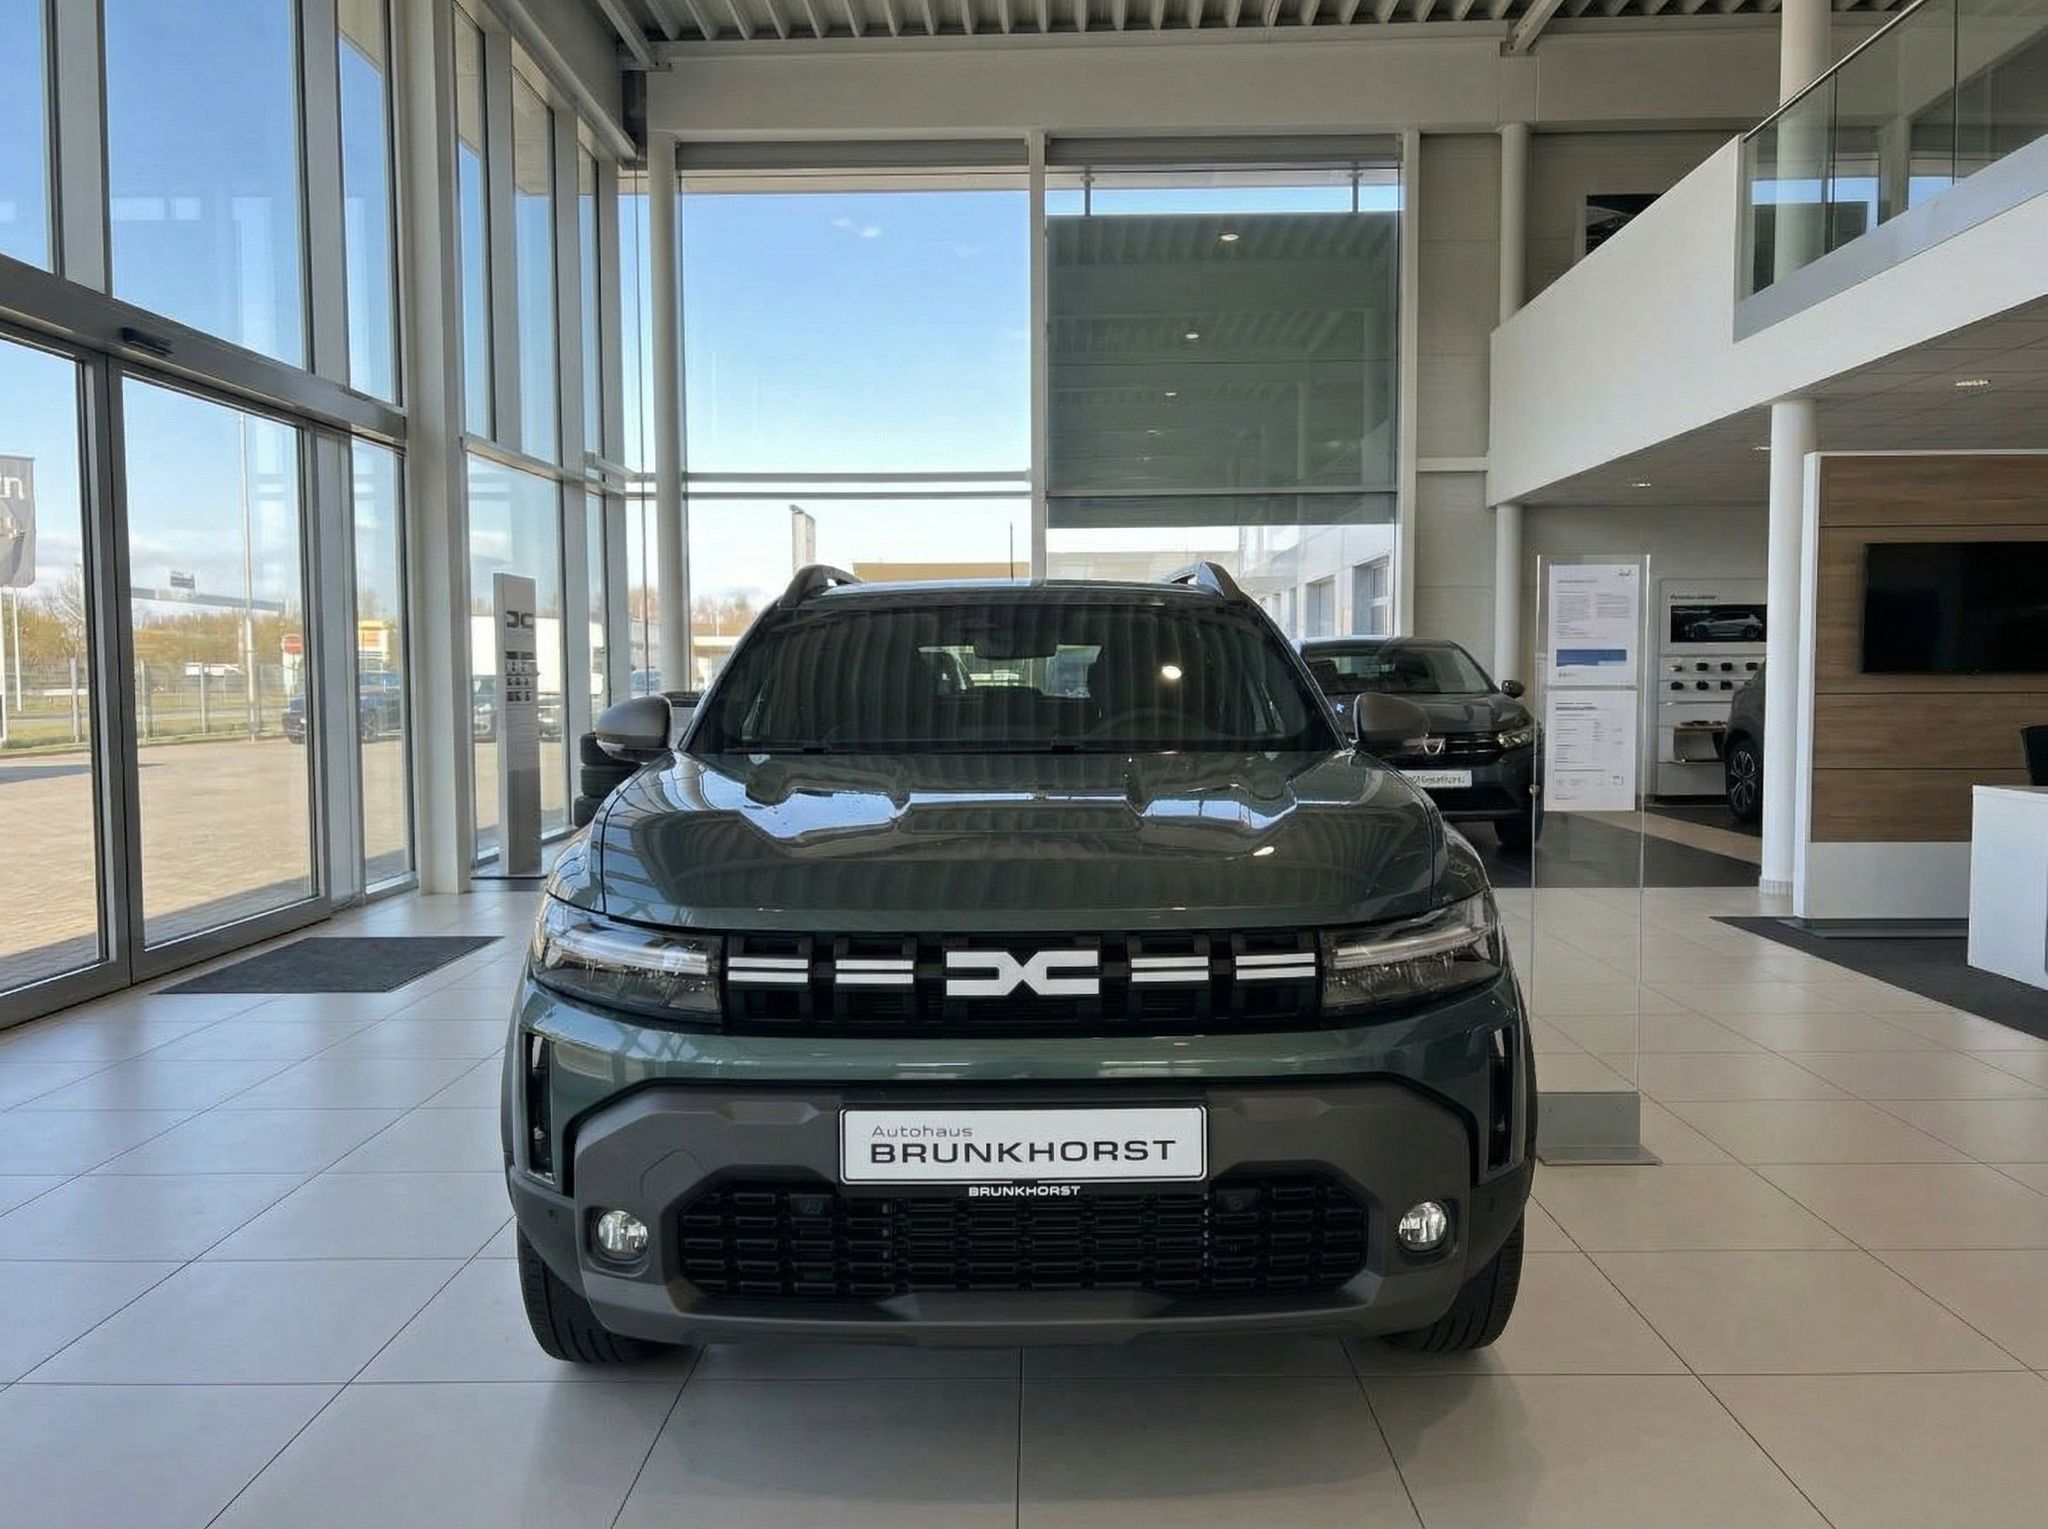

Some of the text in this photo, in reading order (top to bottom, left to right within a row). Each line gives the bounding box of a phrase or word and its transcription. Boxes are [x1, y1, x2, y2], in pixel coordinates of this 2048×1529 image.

[872, 1125, 973, 1138] Autohaus
[870, 1140, 1176, 1163] BRUNKHORST
[969, 1185, 1081, 1197] BRUNKHORST
